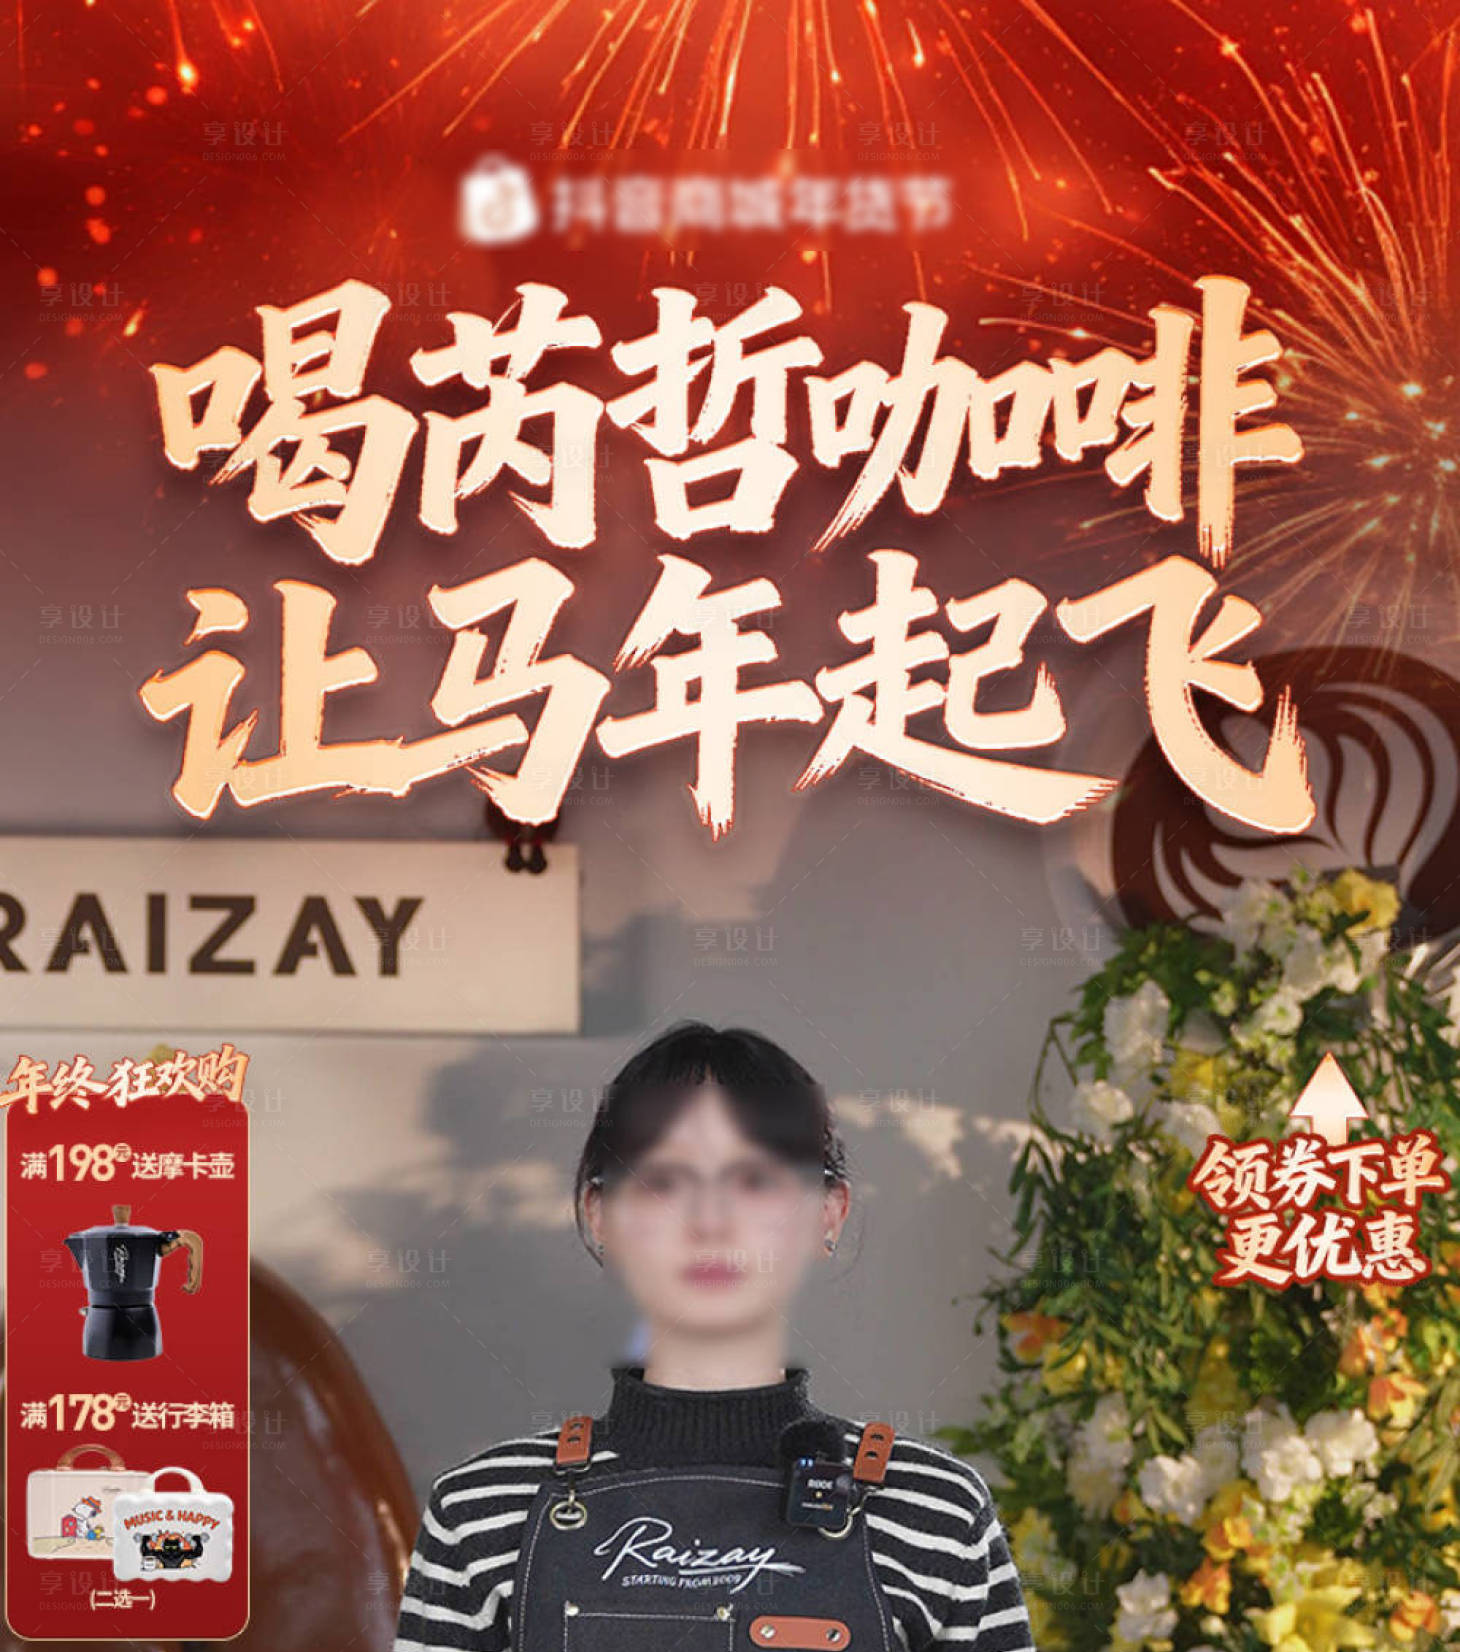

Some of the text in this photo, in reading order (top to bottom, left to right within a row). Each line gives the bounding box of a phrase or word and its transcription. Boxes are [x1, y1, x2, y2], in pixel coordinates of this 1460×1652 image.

[124, 1510, 164, 1530] MUSIC
[178, 1510, 220, 1530] HAPPY
[594, 1517, 806, 1594] Raizay
[622, 1574, 676, 1588] STARTING
